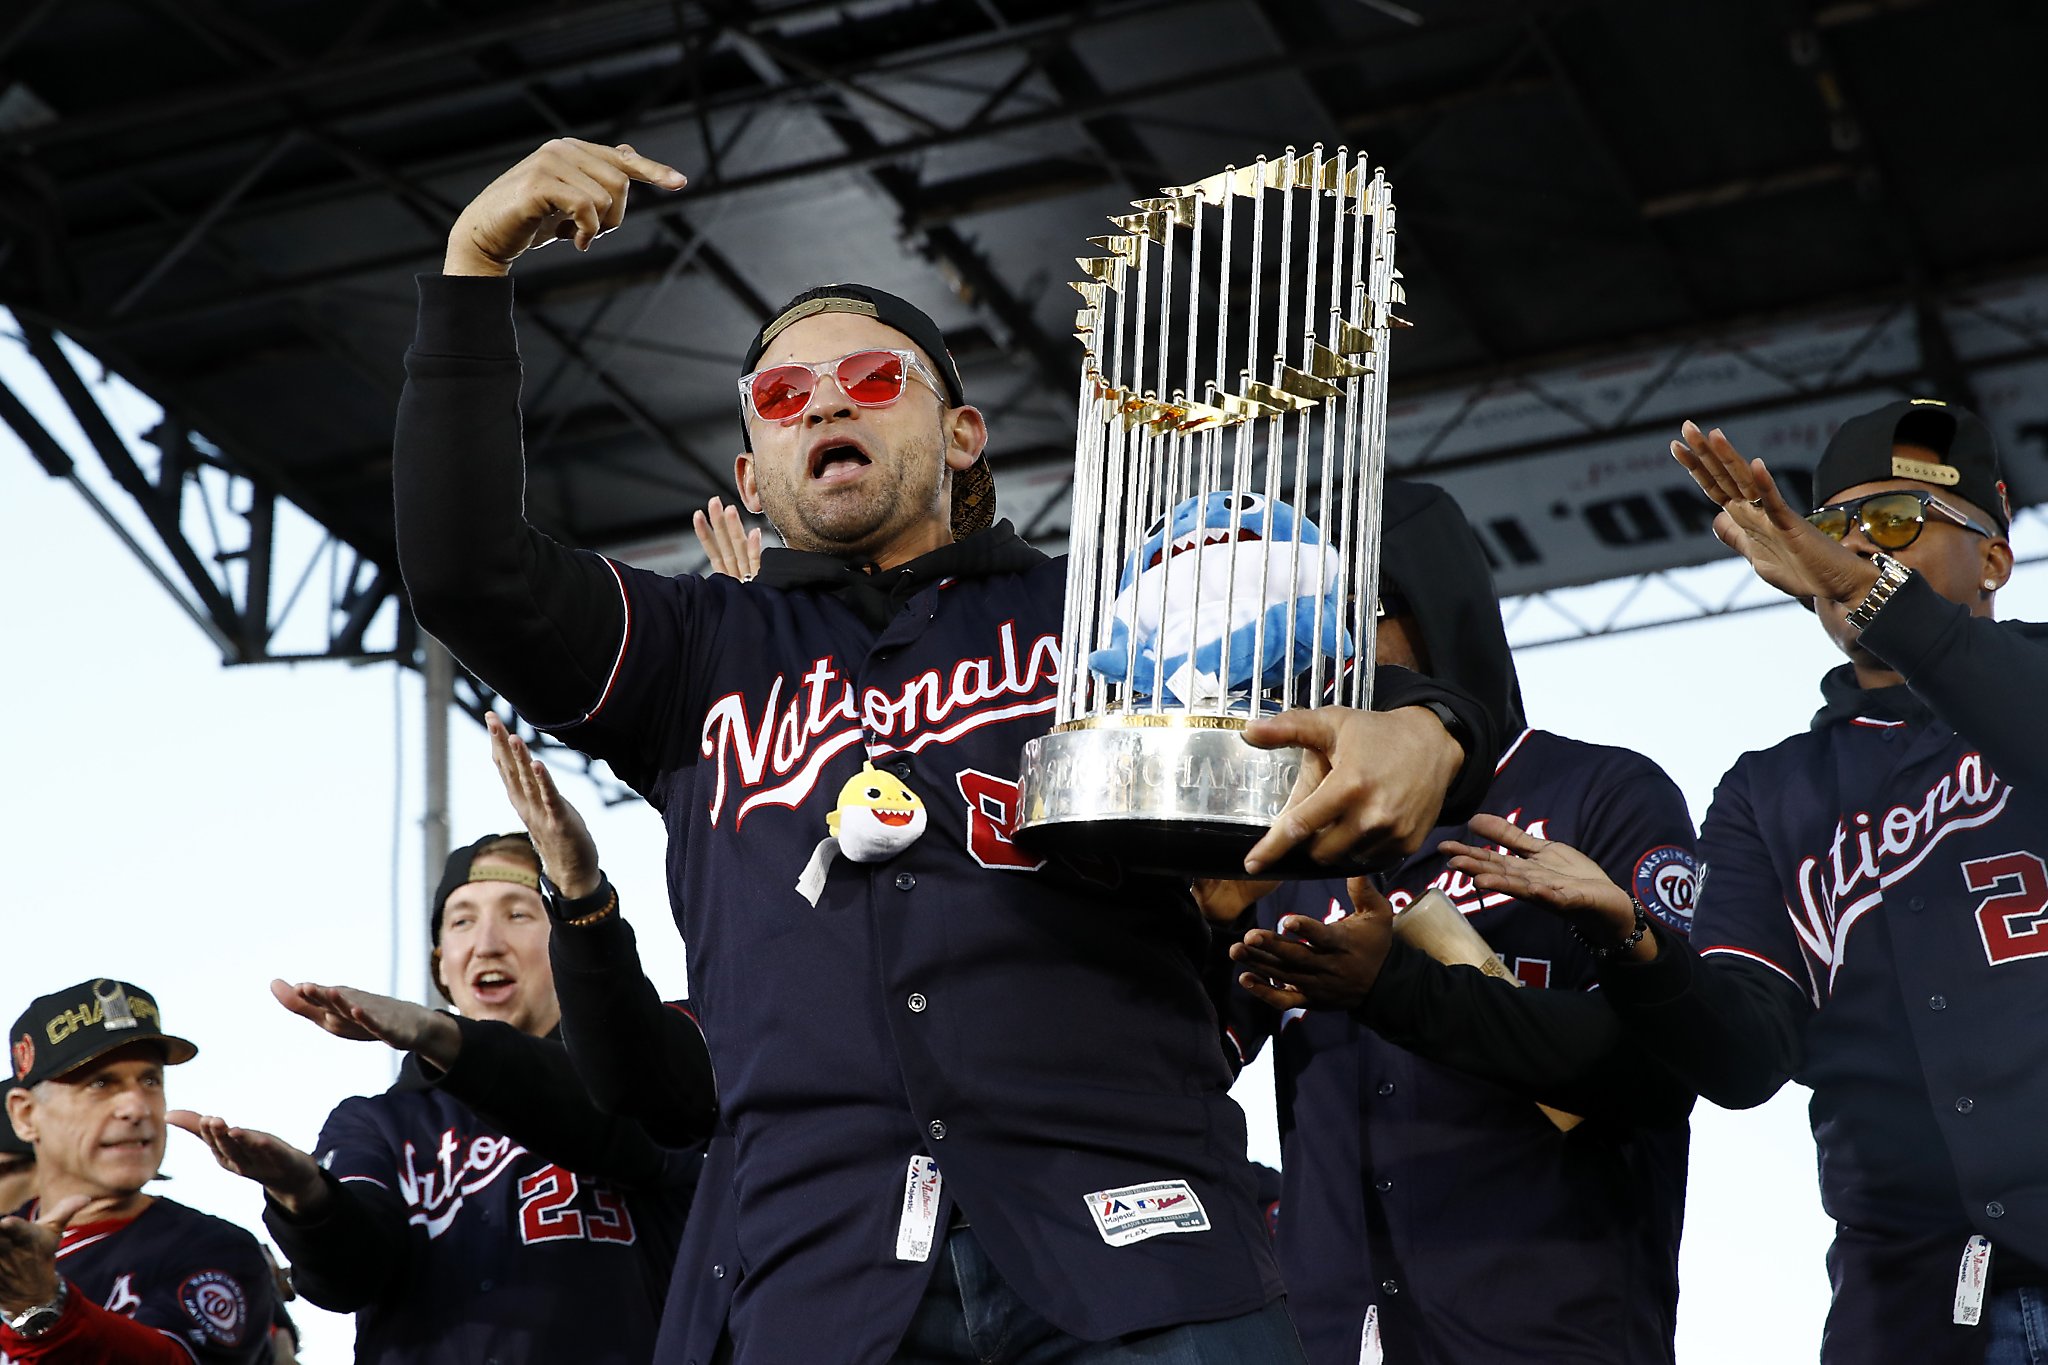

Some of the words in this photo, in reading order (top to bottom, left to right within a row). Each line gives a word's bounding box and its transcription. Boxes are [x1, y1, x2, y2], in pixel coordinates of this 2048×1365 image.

[1639, 850, 1693, 879] WASHING
[1648, 901, 1692, 933] NATIO
[1104, 1211, 1135, 1225] Majestic
